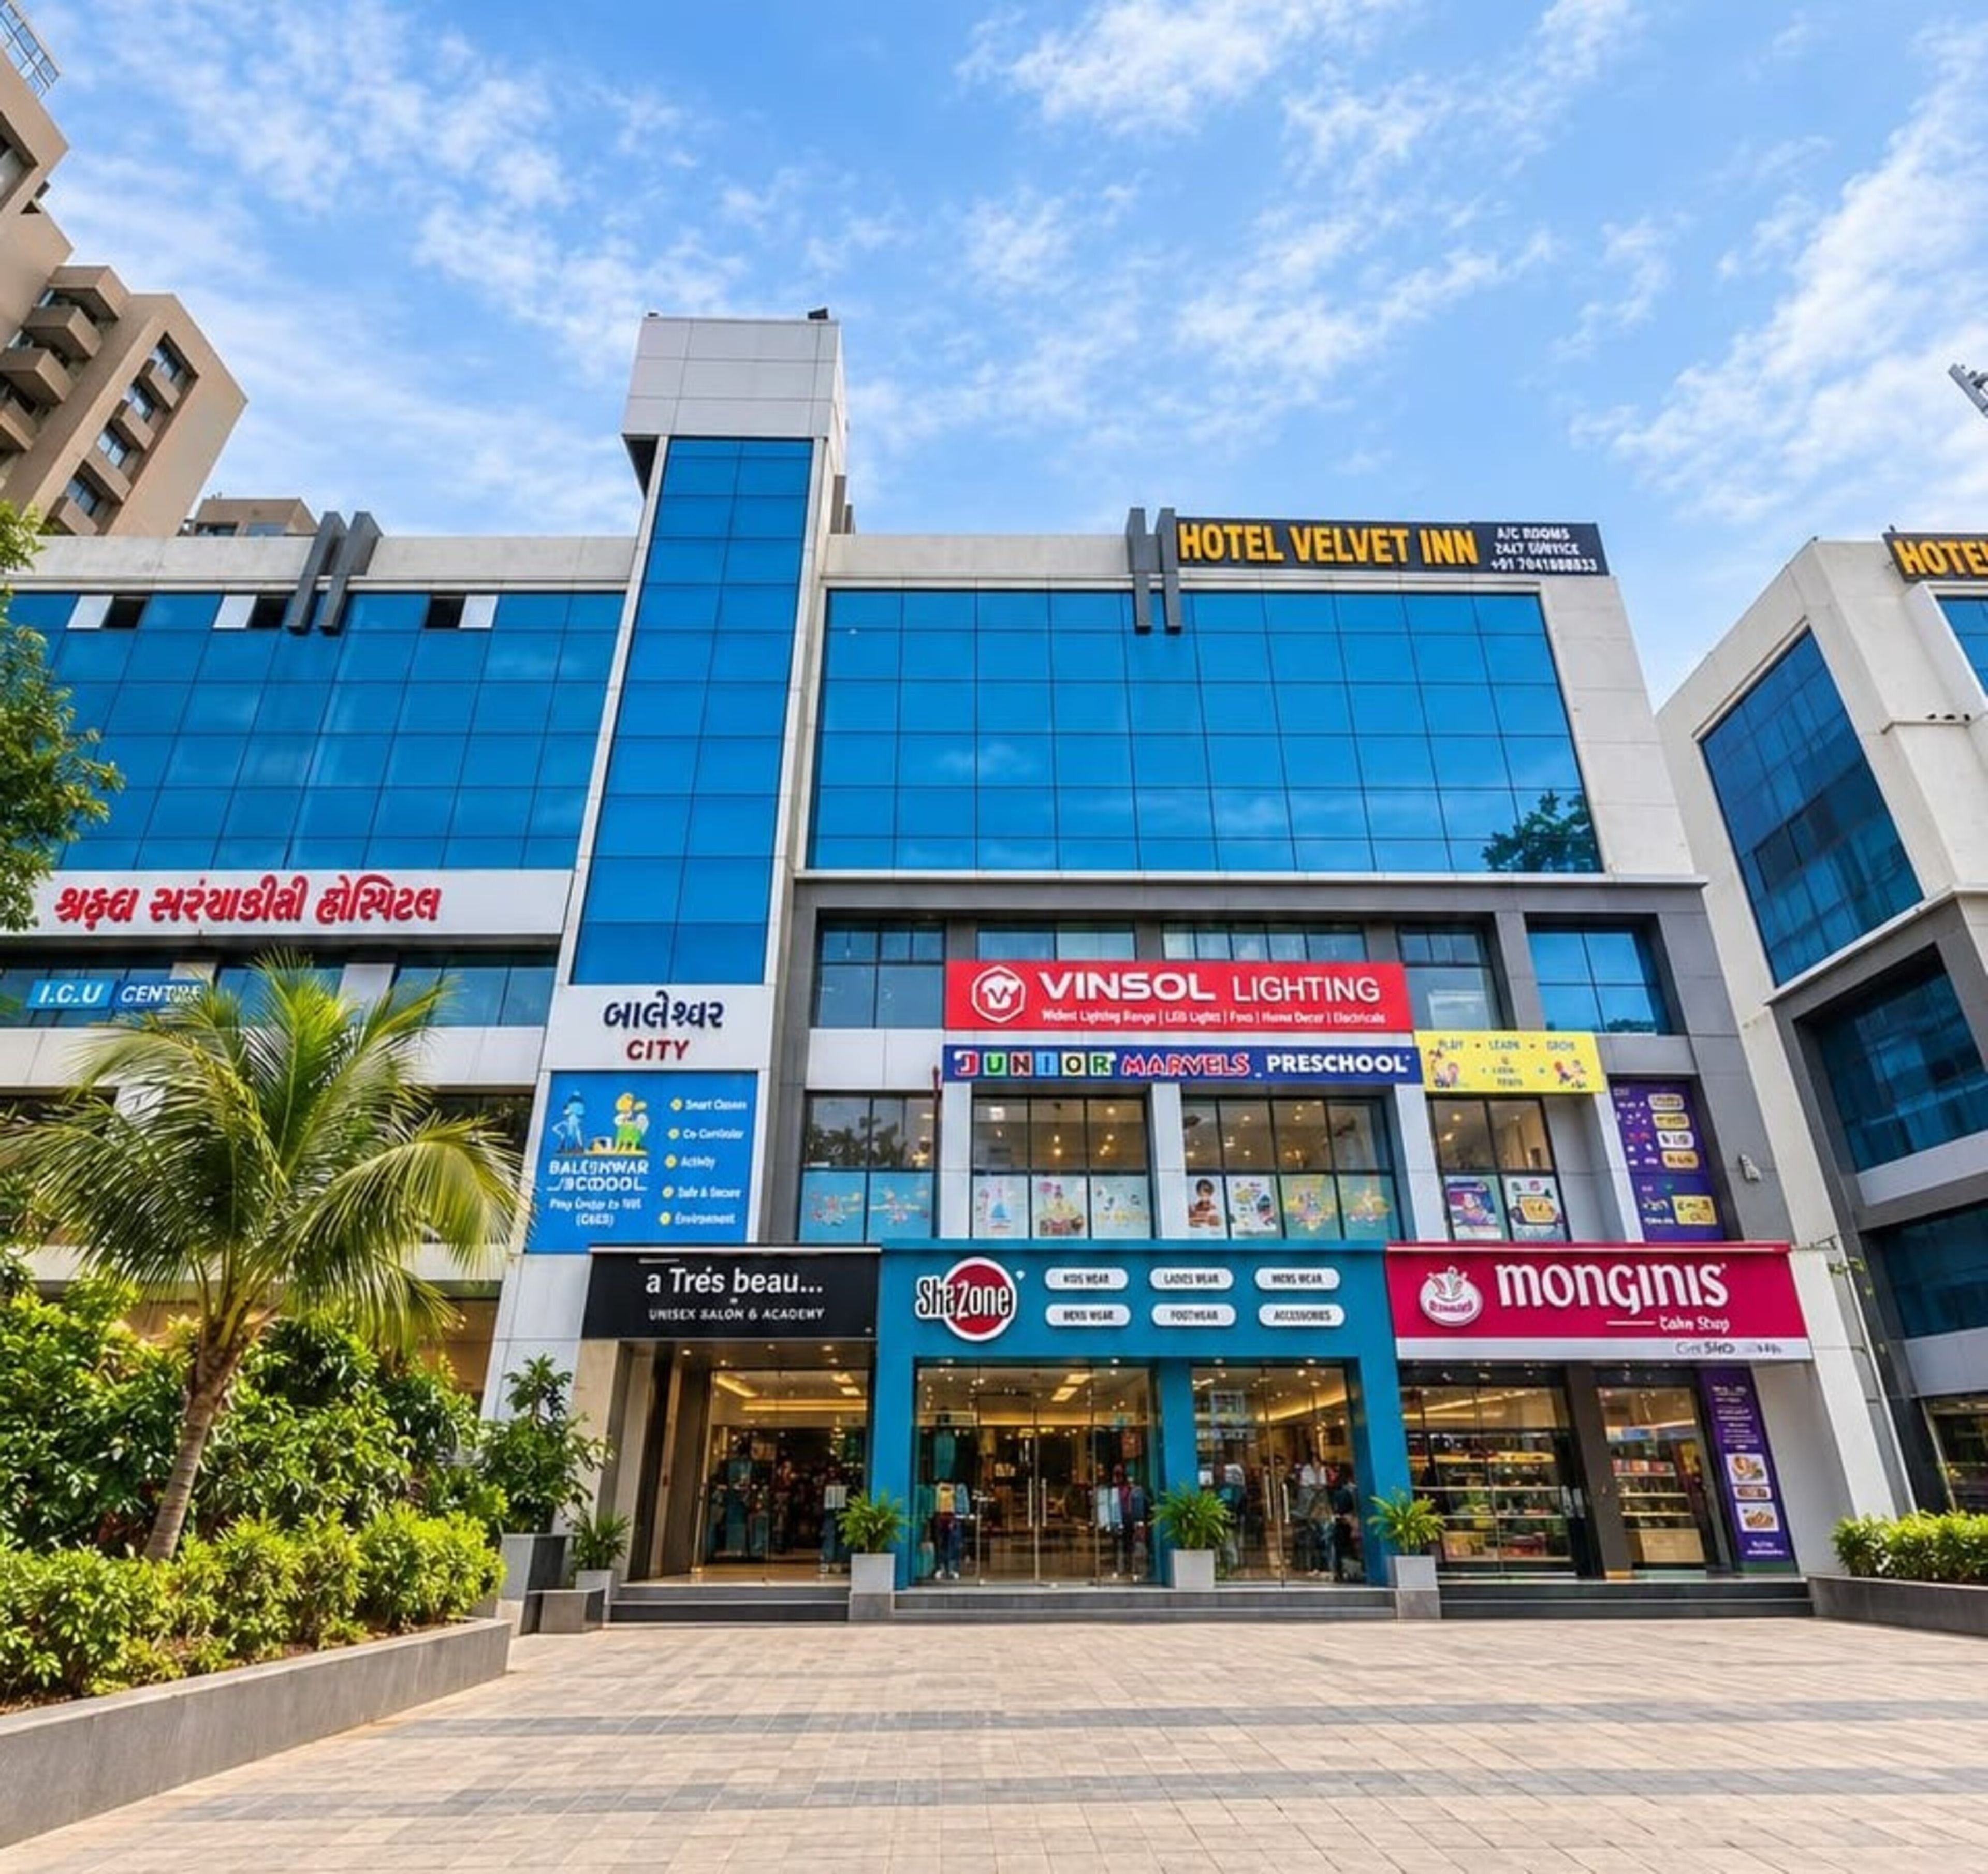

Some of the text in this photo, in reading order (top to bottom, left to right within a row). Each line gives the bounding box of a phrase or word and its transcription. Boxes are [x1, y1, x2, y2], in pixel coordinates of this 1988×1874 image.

[1178, 524, 1479, 564] HOTEL VELVET INN
[1037, 972, 1381, 1003] VINSOL LIGHTING
[626, 1039, 690, 1060] CITY
[954, 1050, 1408, 1077] JUNIOR MARVELS PRESCHOOL
[645, 1273, 662, 1293] a
[732, 1267, 824, 1294] beau...
[648, 1308, 697, 1321] UNISEX
[699, 1308, 745, 1320] SALON
